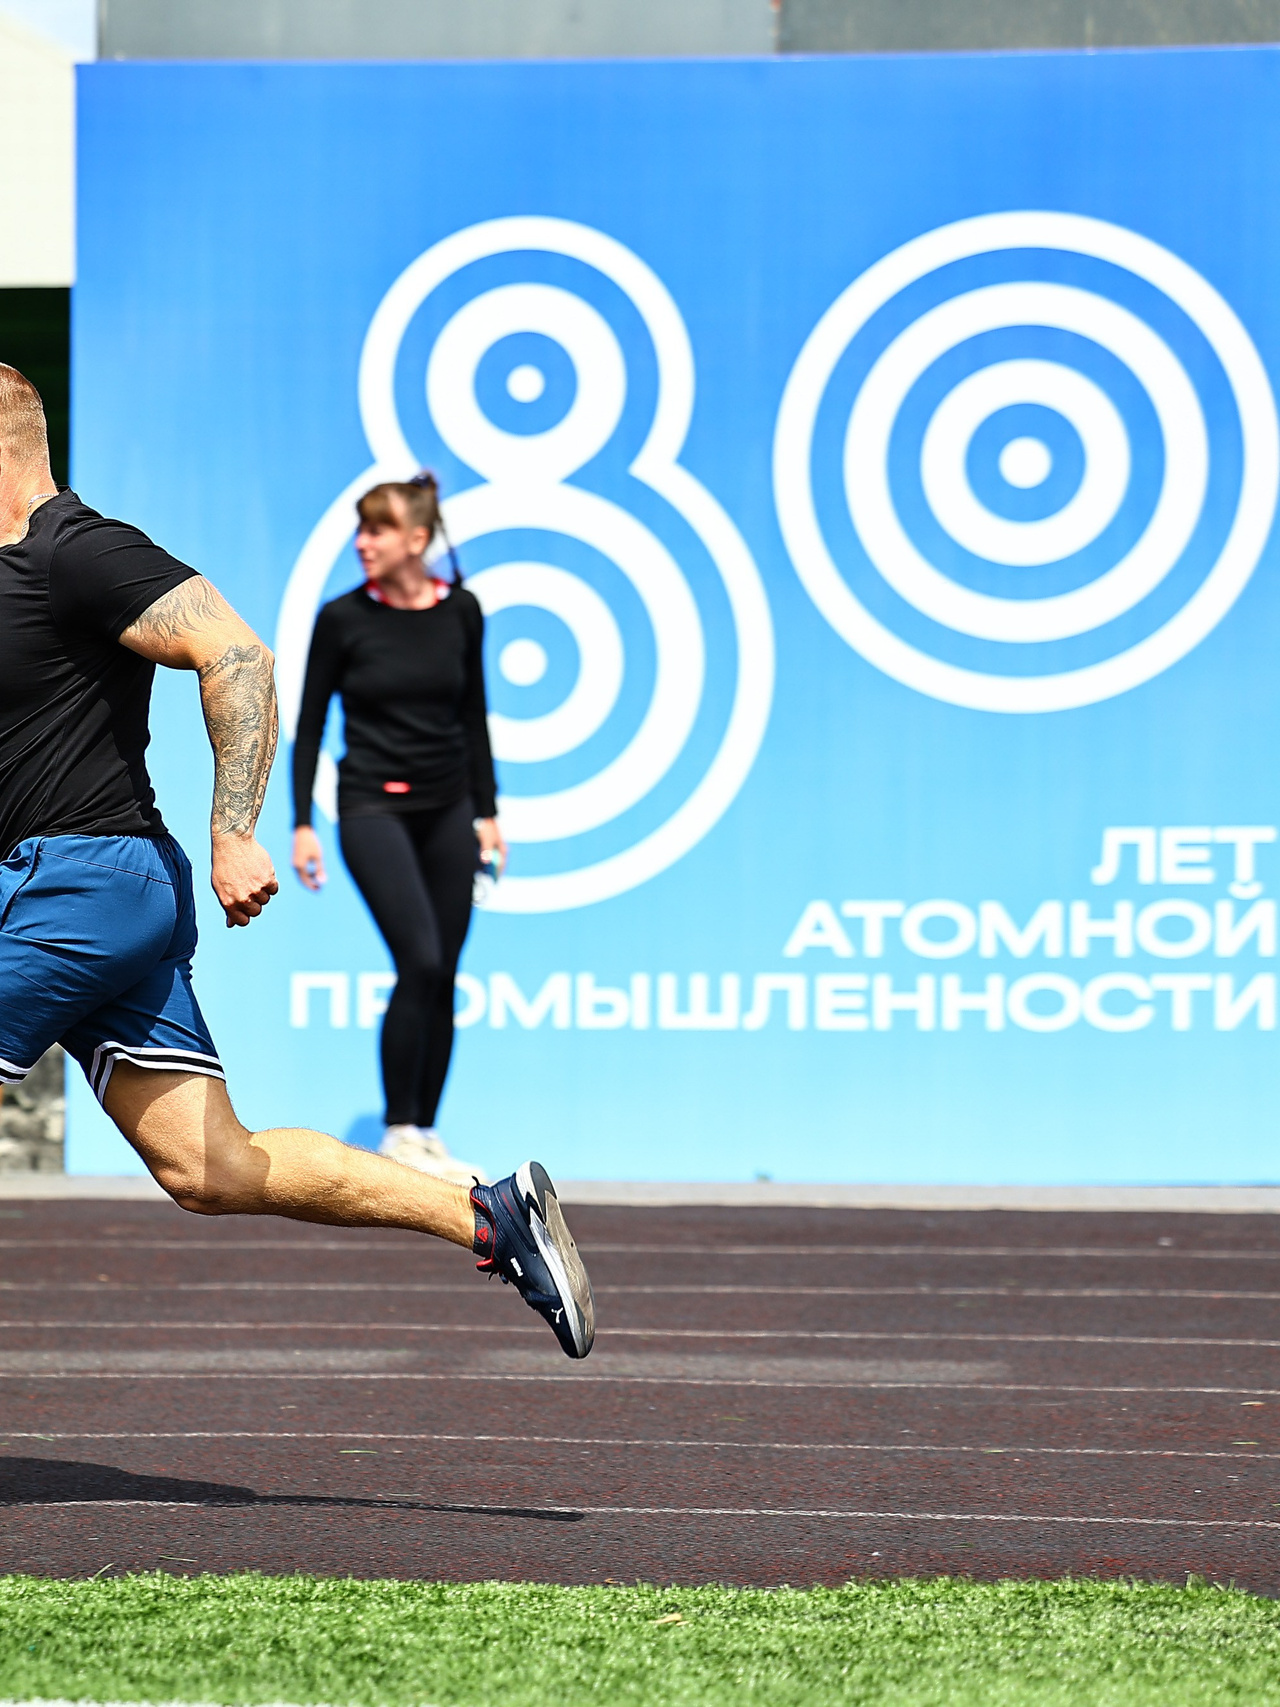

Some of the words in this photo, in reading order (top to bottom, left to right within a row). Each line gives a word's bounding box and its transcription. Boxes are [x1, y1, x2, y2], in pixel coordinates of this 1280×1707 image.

[275, 211, 1280, 914] 80
[1091, 826, 1277, 886] ЛЕТ
[784, 881, 1276, 959] АТОМНОЙ
